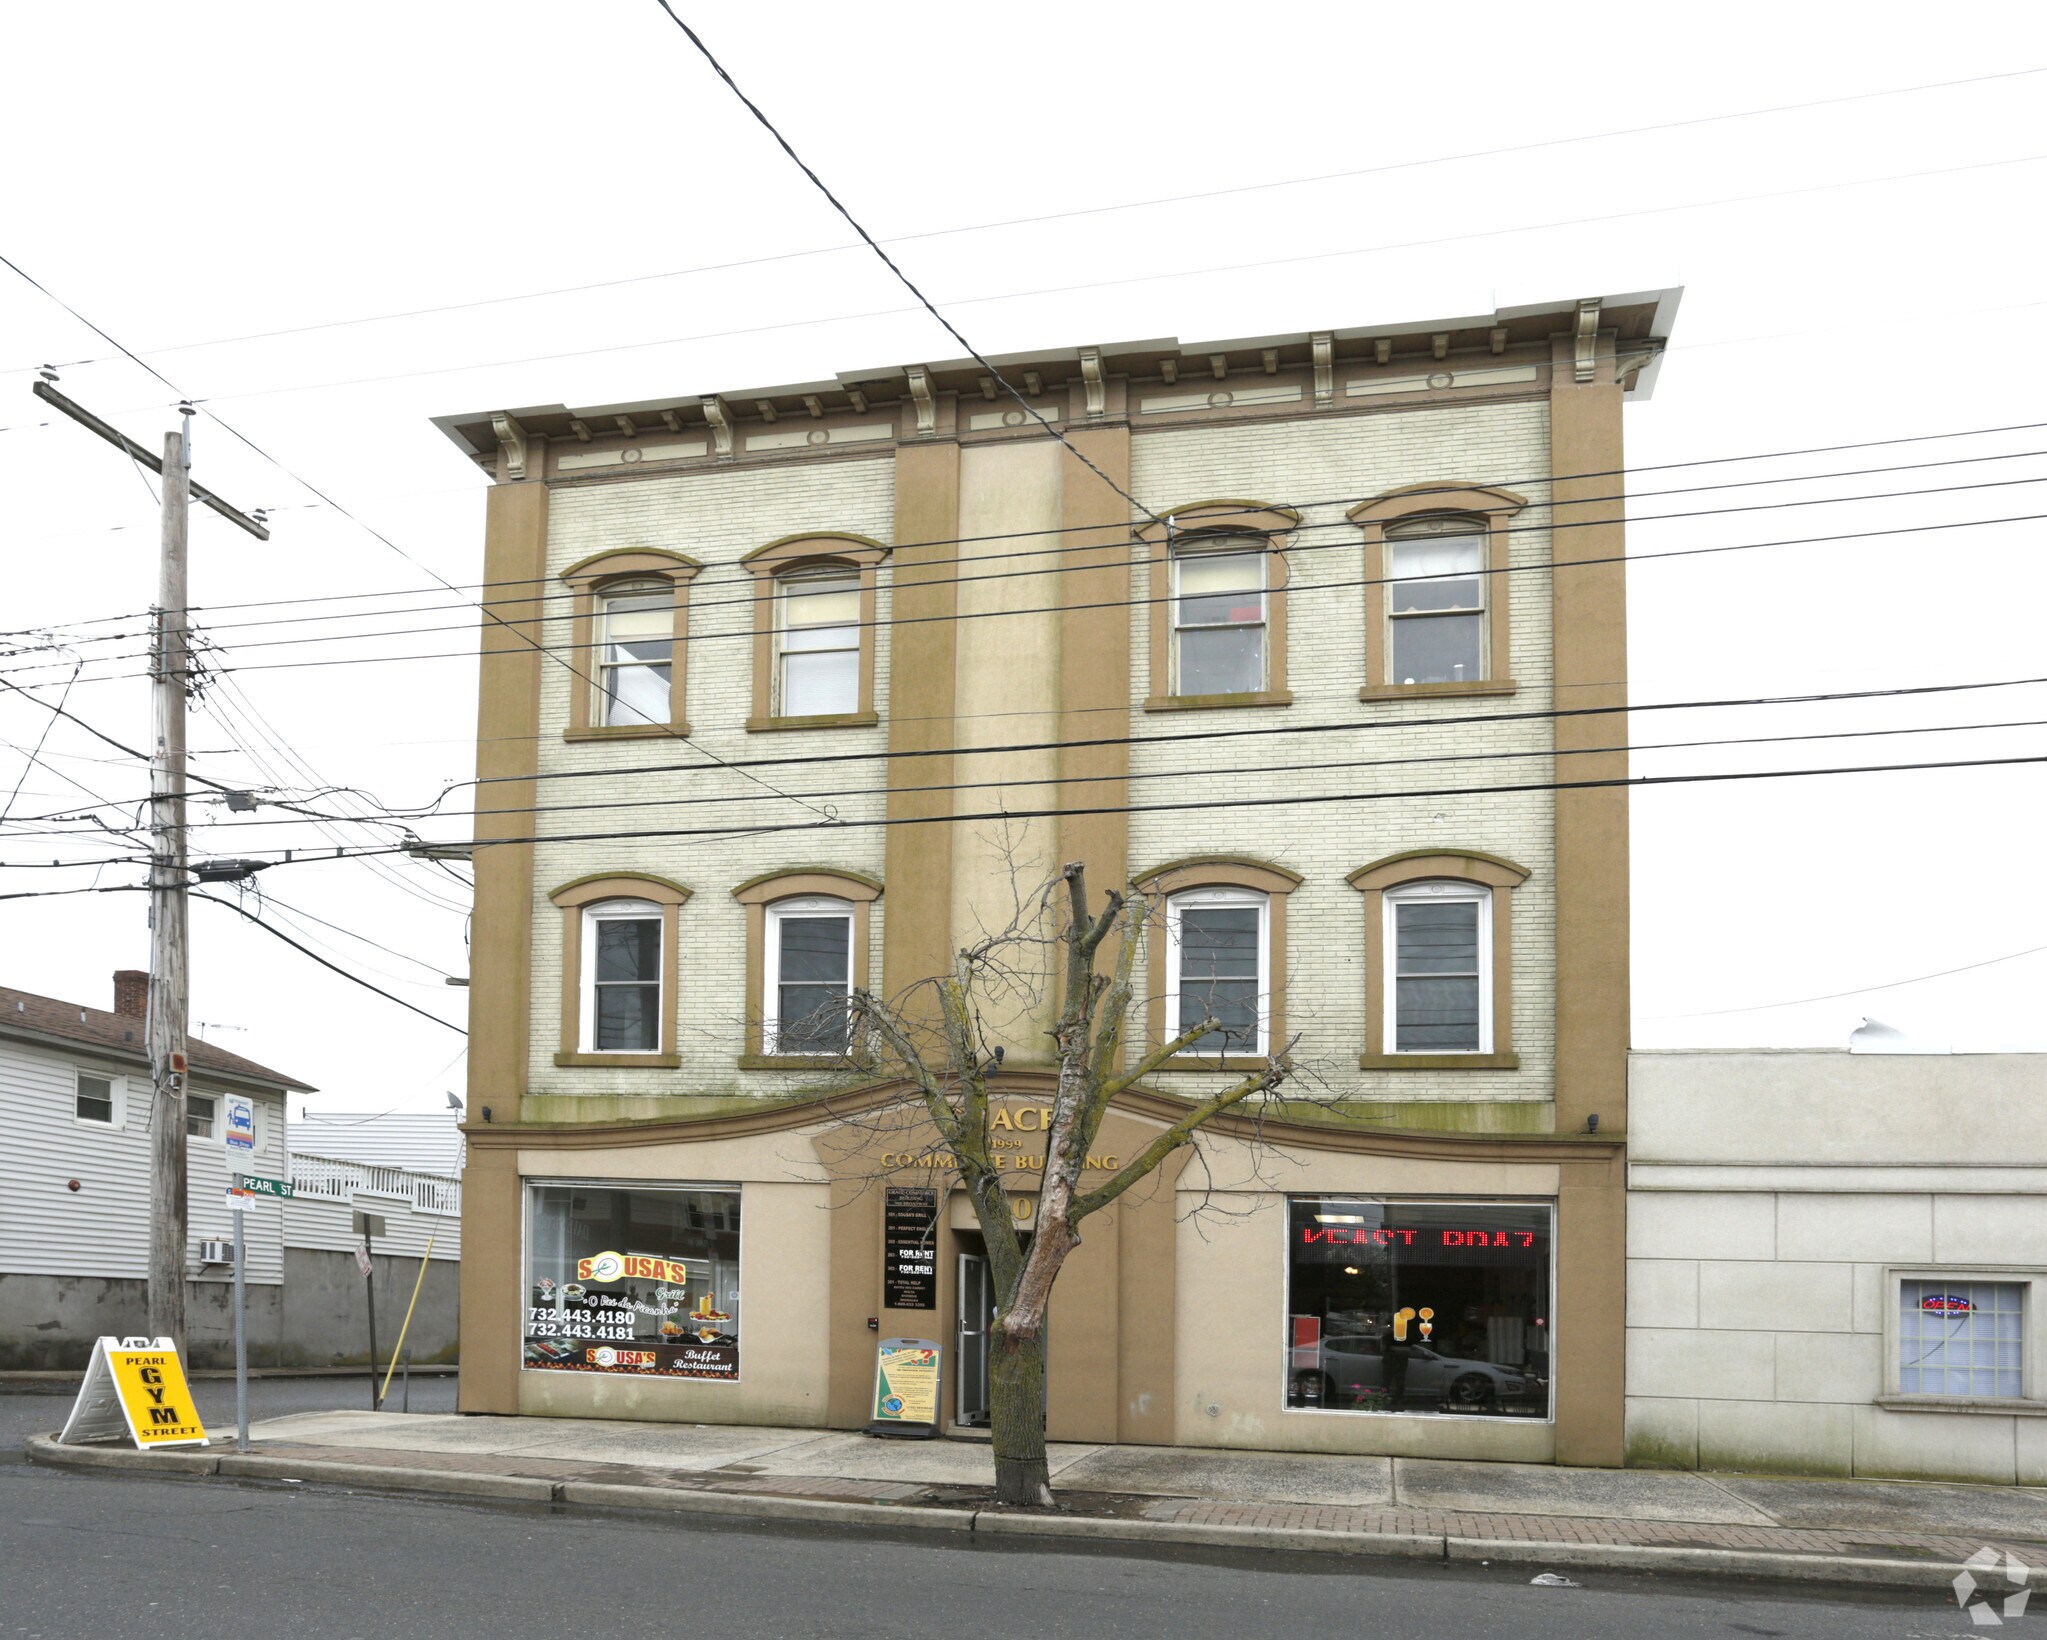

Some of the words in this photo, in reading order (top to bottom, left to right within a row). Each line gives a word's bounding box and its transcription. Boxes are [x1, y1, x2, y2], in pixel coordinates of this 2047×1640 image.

[243, 1177, 276, 1194] PEARL
[281, 1184, 293, 1196] ST
[655, 1287, 685, 1301] Grill
[1923, 1300, 1971, 1311] OPEN
[528, 1307, 635, 1325] 732.443.4180
[528, 1322, 635, 1341] 732.443.4181
[126, 1357, 167, 1365] PEARL
[684, 1349, 721, 1362] Buffet
[672, 1358, 733, 1372] Restaurant
[142, 1427, 198, 1437] STREET
